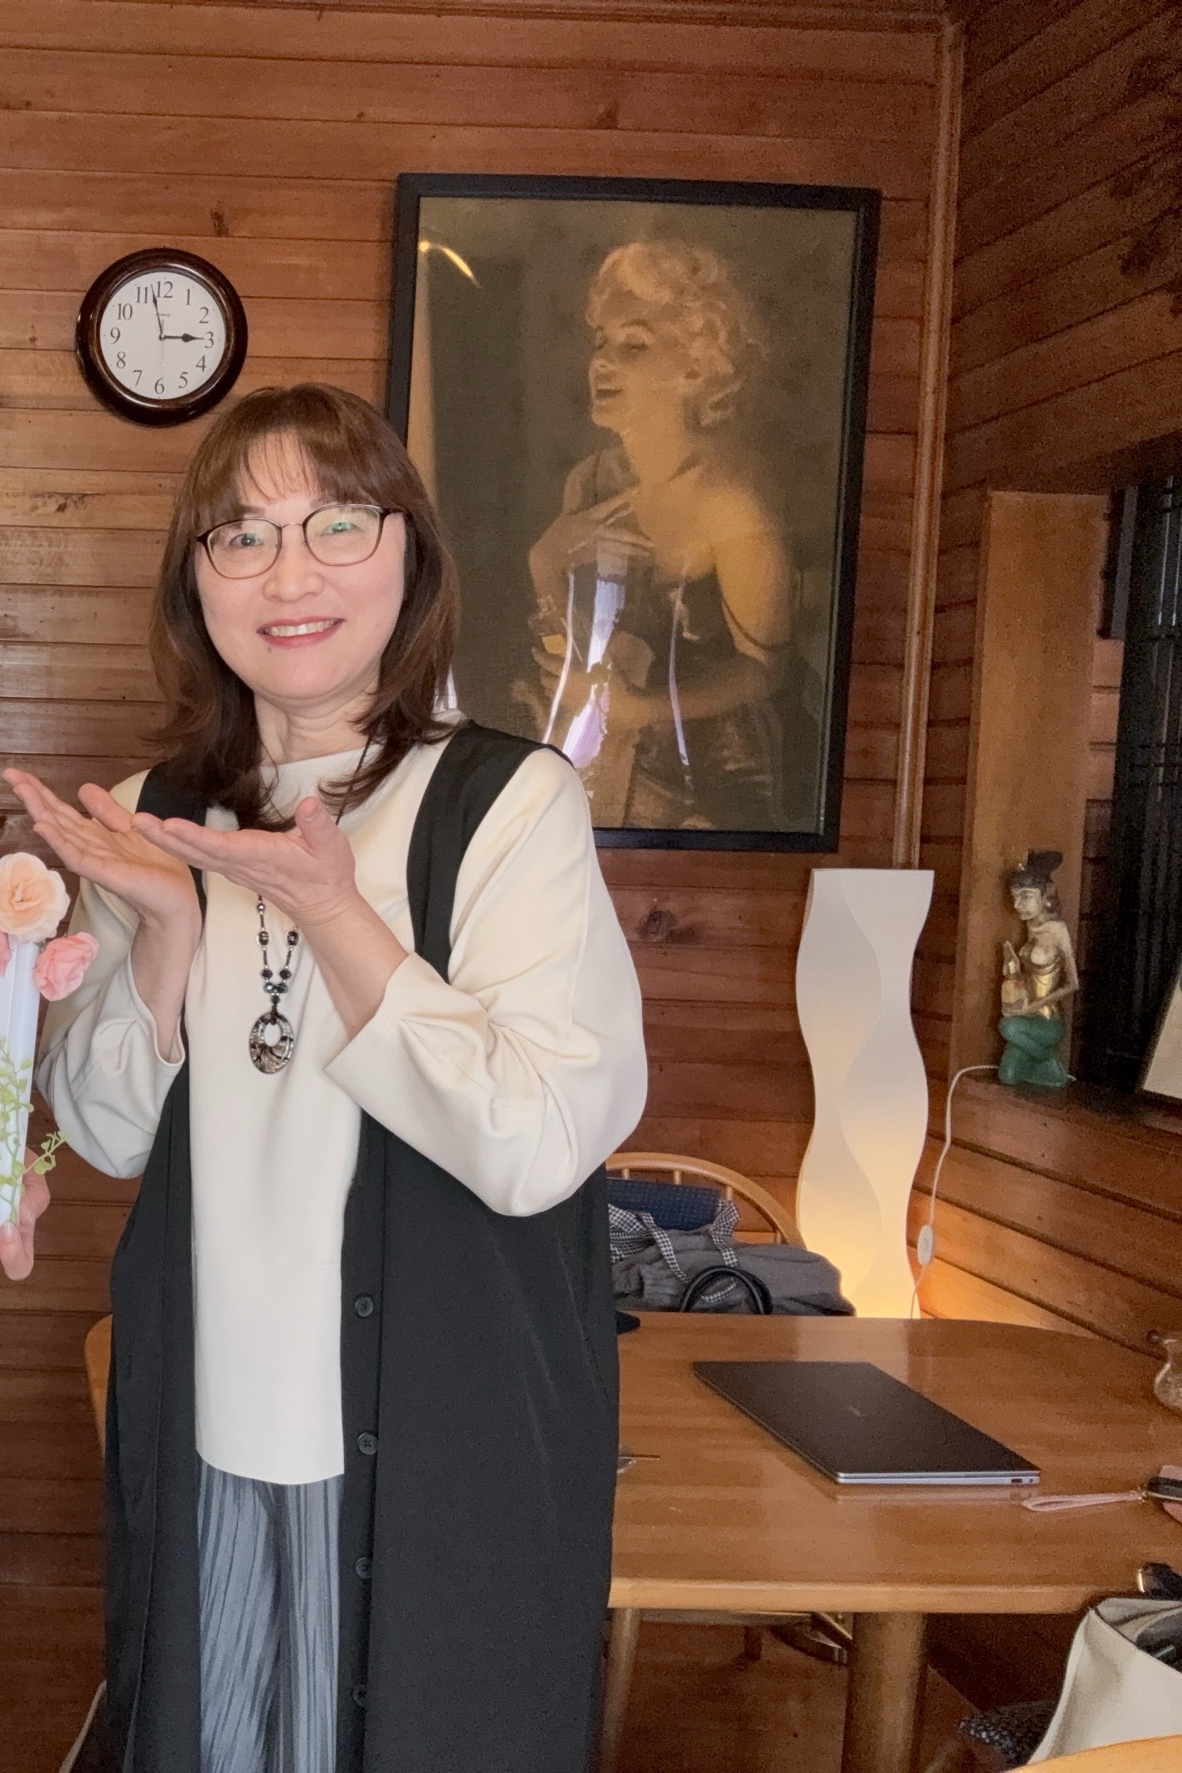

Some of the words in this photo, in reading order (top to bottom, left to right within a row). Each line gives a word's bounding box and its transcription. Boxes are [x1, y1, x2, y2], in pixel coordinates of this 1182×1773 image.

[136, 286, 148, 304] 11
[156, 281, 173, 298] 12
[186, 289, 191, 305] 1
[117, 303, 133, 320] 10
[199, 307, 209, 323] 2
[110, 327, 121, 344] 9
[204, 331, 214, 348] 3
[116, 352, 126, 369] 8
[196, 355, 206, 372] 4
[133, 370, 142, 387] 7
[154, 377, 164, 394] 6
[178, 372, 188, 388] 5
